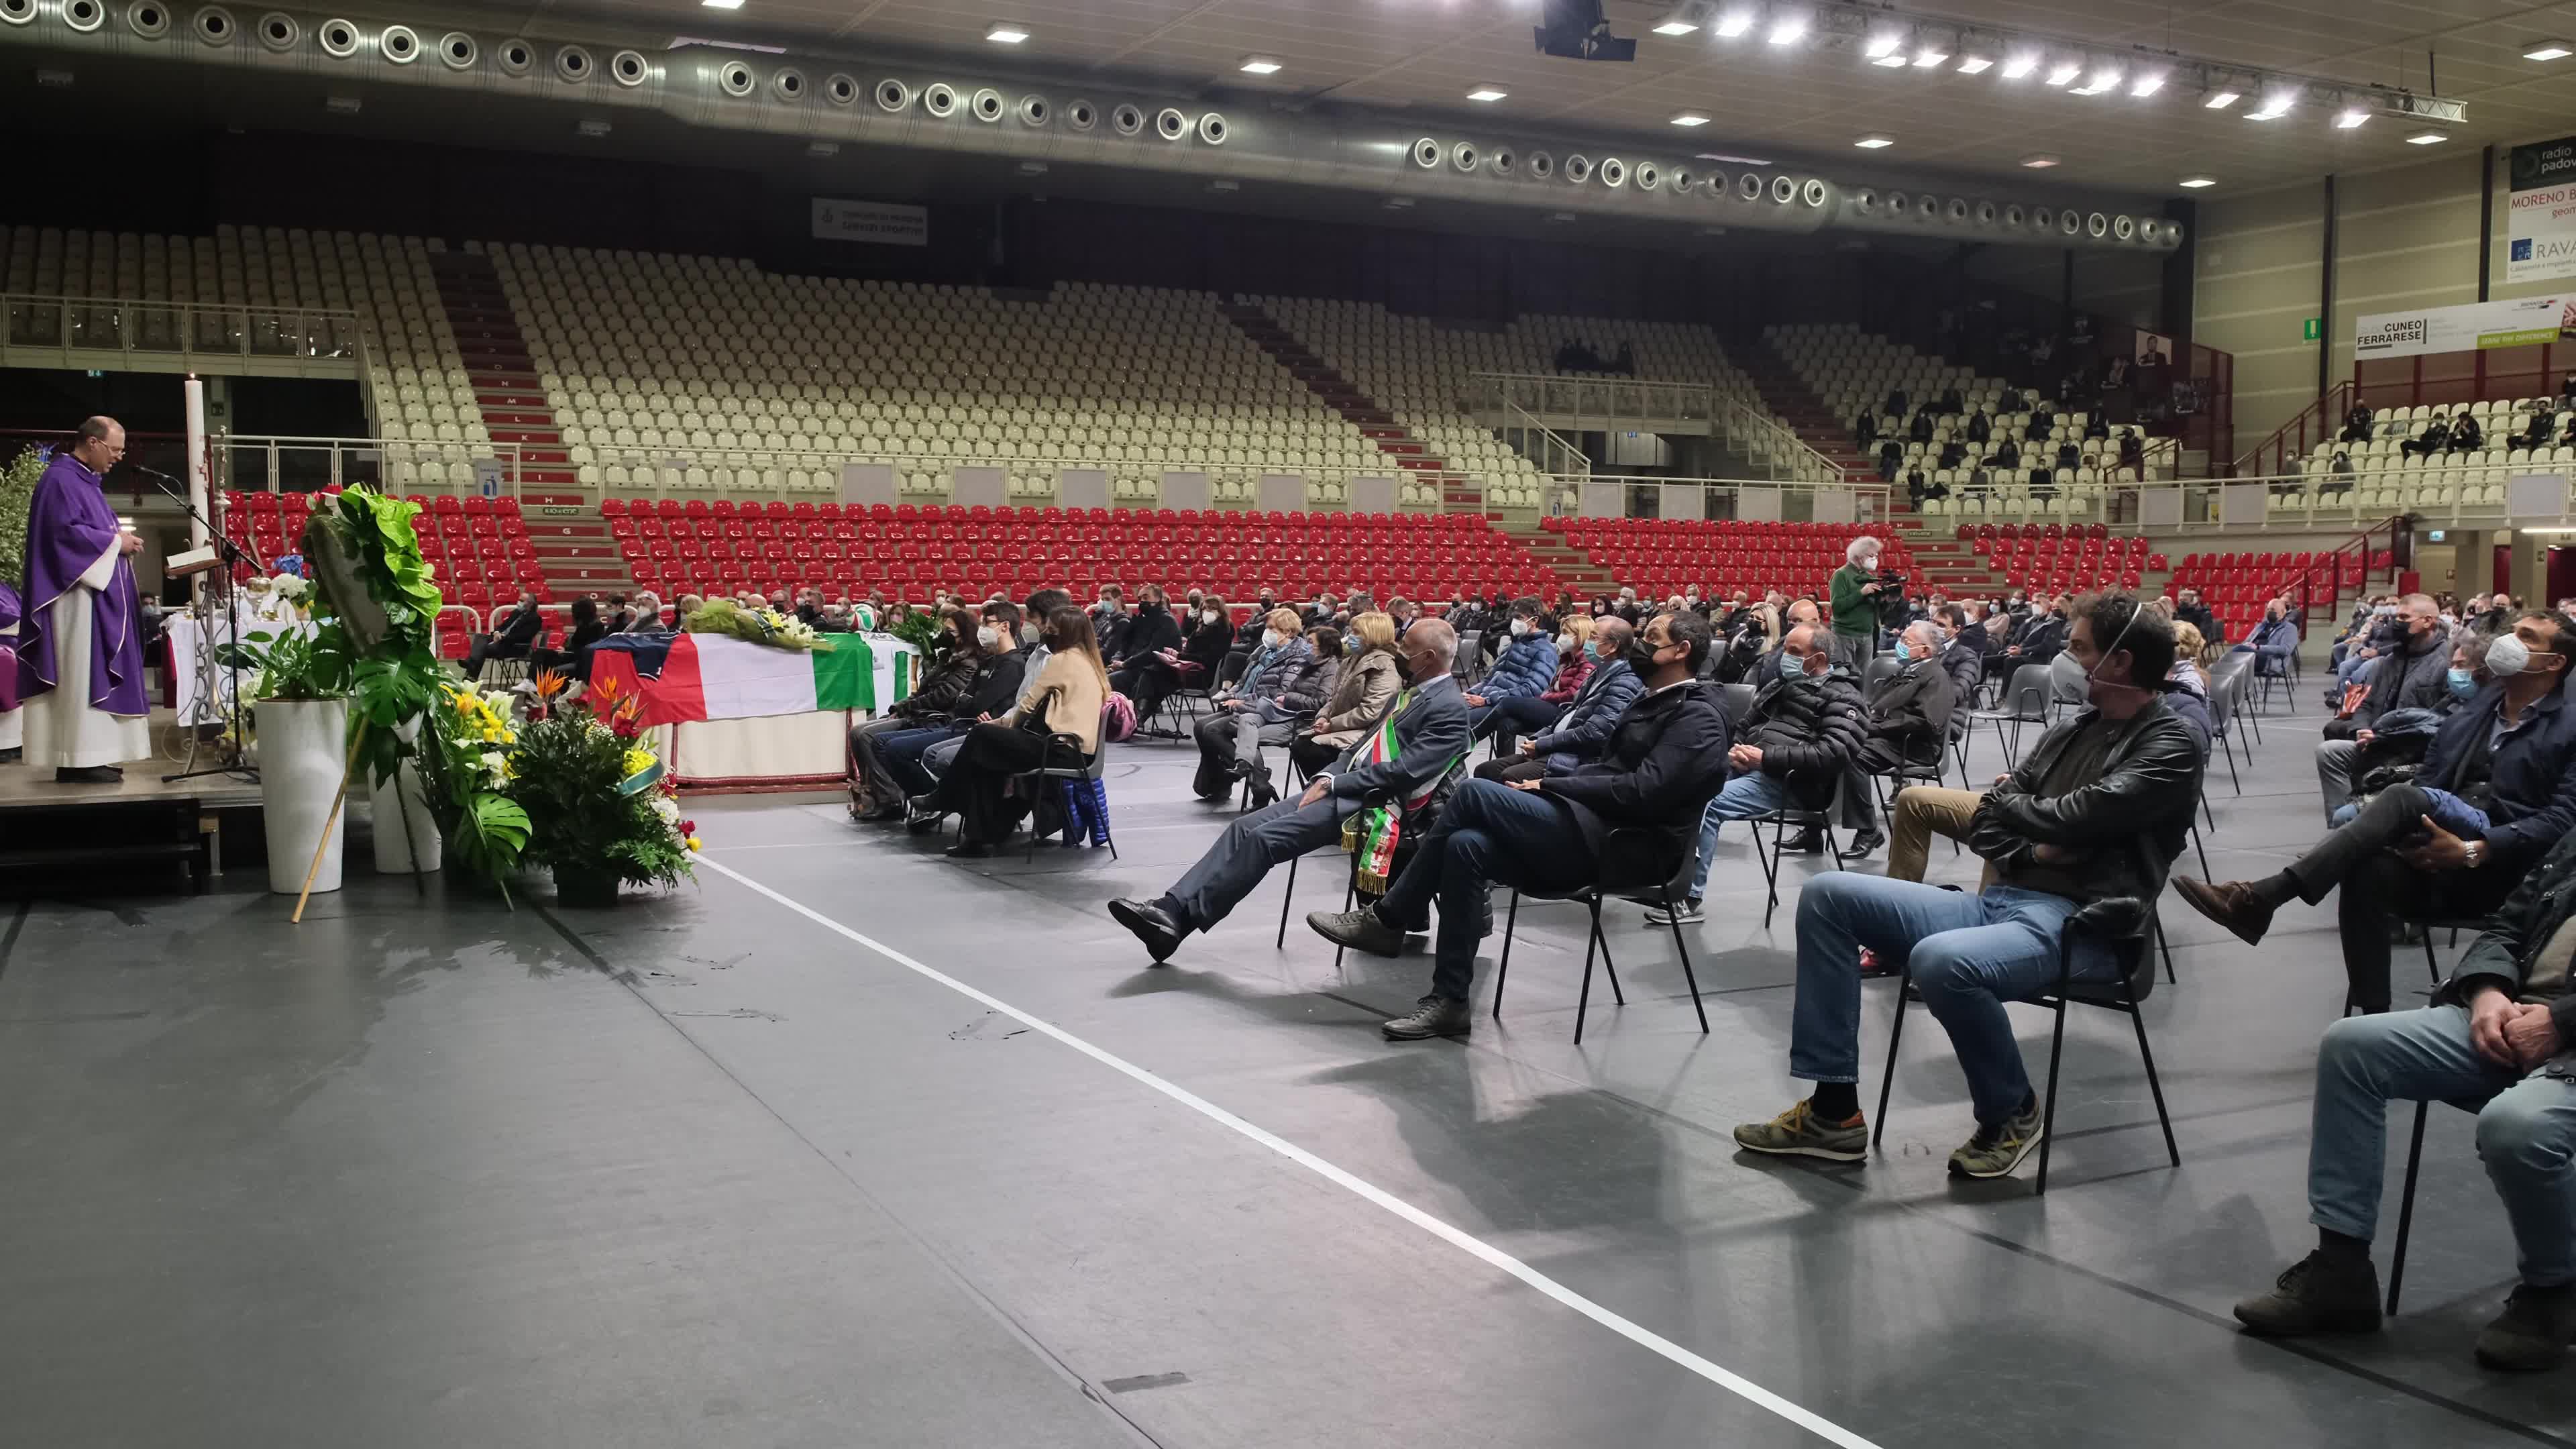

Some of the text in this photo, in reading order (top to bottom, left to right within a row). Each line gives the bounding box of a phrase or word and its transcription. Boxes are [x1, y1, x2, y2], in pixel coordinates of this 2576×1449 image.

[2542, 147, 2571, 159] radio
[2512, 191, 2565, 209] MORENO
[2385, 321, 2422, 332] CUNEO
[2357, 331, 2421, 345] FERRARESE
